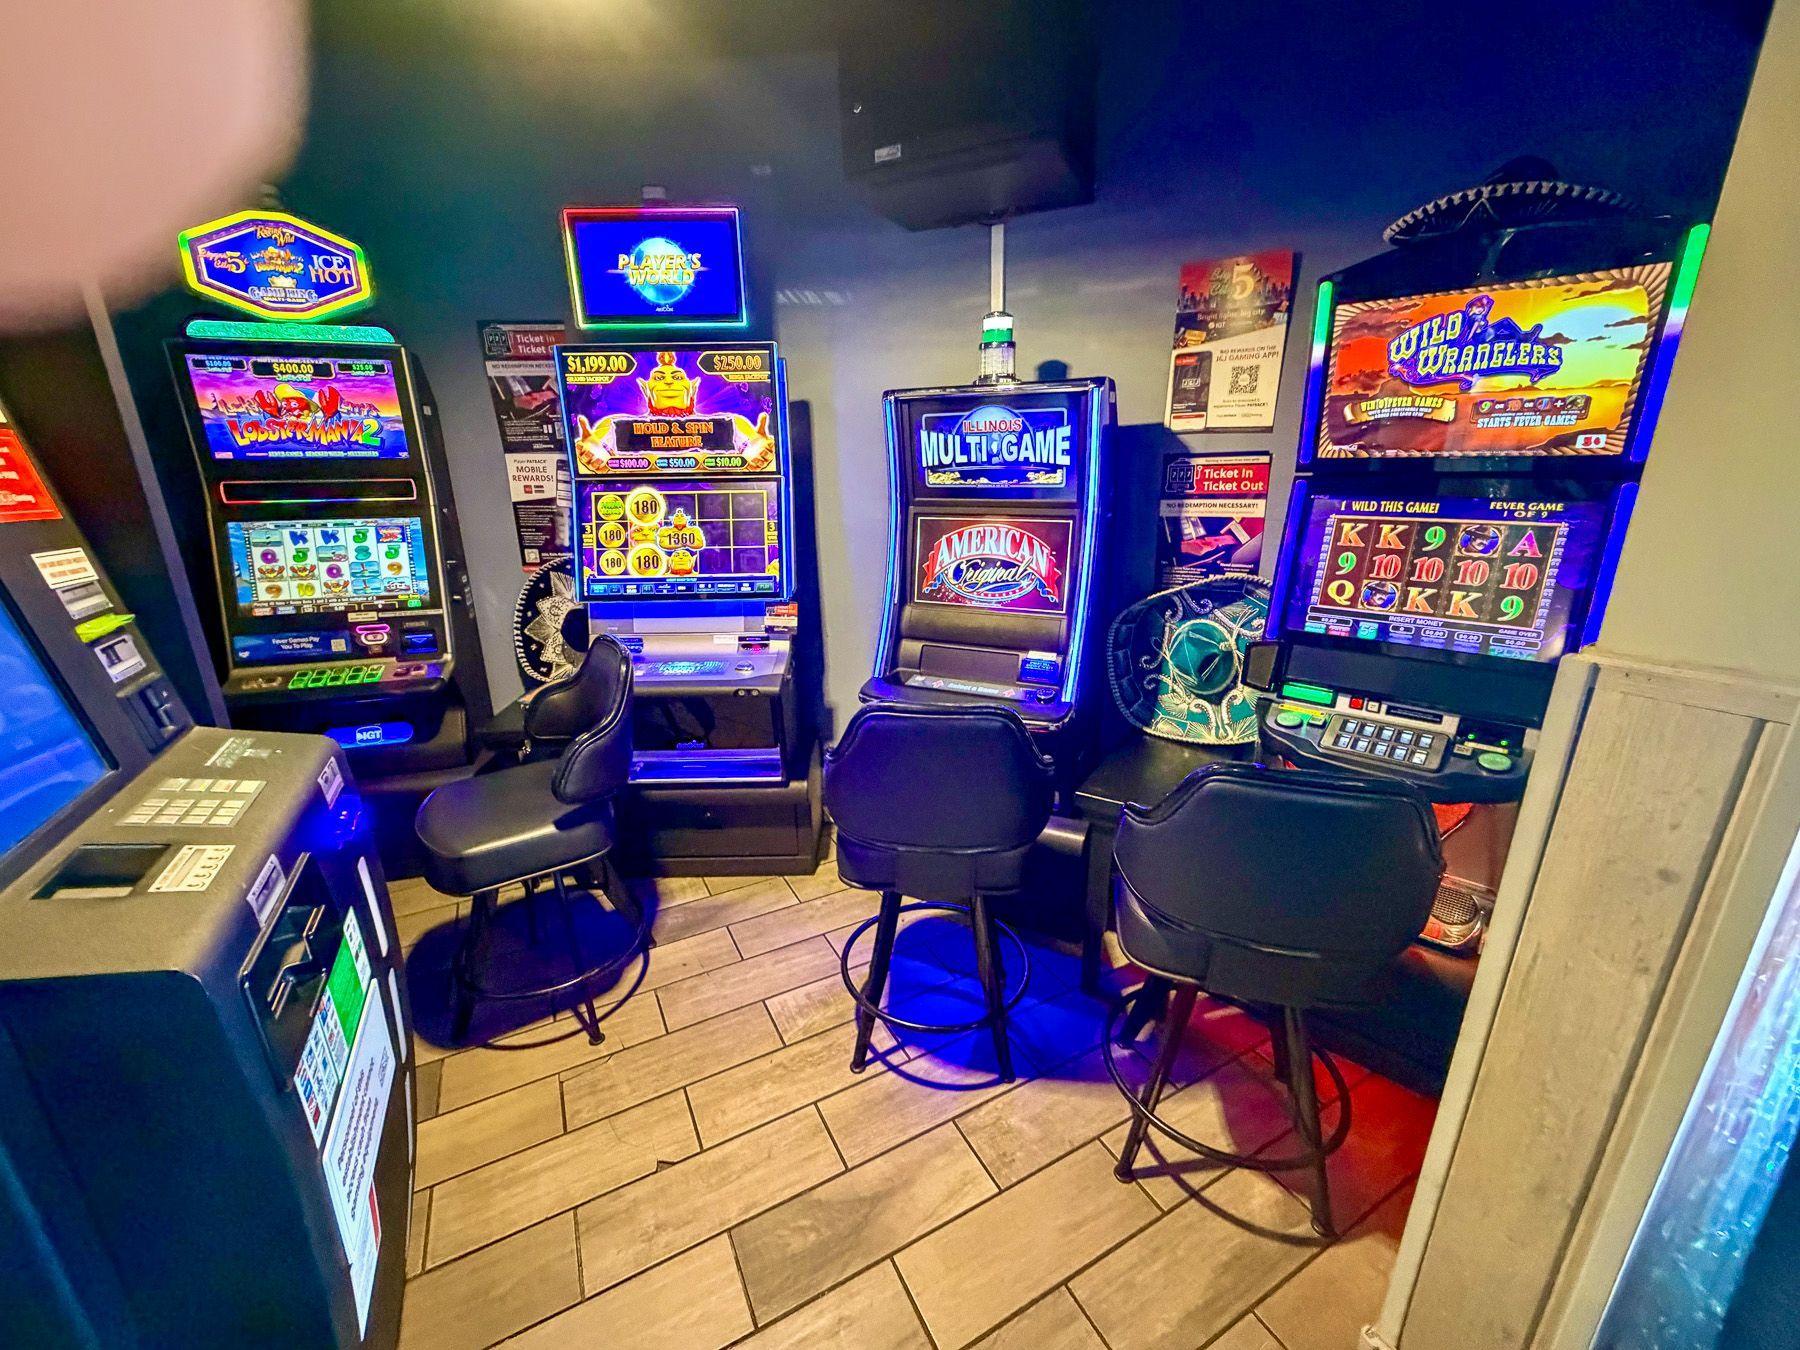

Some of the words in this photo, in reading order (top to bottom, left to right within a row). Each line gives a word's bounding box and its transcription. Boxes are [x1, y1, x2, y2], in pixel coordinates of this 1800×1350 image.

[311, 254, 345, 270] ICE
[618, 253, 702, 271] PLAYER'S
[308, 264, 352, 285] HOT
[629, 269, 695, 286] WORLD
[515, 333, 545, 343] Ticket
[546, 334, 556, 342] In
[1390, 312, 1463, 363] WILD
[518, 344, 547, 354] Ticket
[567, 355, 628, 373] $1,199.00
[713, 355, 762, 371] $250.00
[1418, 341, 1562, 377] WRANGLERS
[272, 362, 314, 374] $400.00
[633, 422, 670, 435] HOLD
[671, 423, 684, 434] &
[685, 422, 714, 434] SPIN
[963, 418, 1023, 433] ILLINOIS
[1477, 416, 1512, 428] STARTS
[1513, 415, 1543, 427] FEVER
[1544, 414, 1578, 426] GAMES
[362, 418, 382, 446] 2
[651, 436, 704, 448] FEATURE
[920, 429, 988, 467] MULTI
[1001, 424, 1072, 466] GAME
[669, 460, 696, 468] $50.00
[716, 459, 742, 467] $10.00
[1204, 468, 1239, 479] Ticket
[1241, 468, 1254, 478] In
[1203, 481, 1237, 491] Ticket
[1240, 481, 1264, 491] Out
[634, 500, 658, 515] 180
[1352, 501, 1378, 512] WILD
[1380, 501, 1404, 513] THIS
[1405, 502, 1440, 514] GAME!
[1489, 501, 1525, 510] FEVER
[1528, 502, 1565, 512] GAME
[1541, 511, 1548, 519] 9
[289, 531, 309, 547] K
[320, 531, 340, 546] K
[353, 529, 369, 544] J
[604, 530, 622, 541] 180
[667, 533, 696, 546] 1360
[1337, 522, 1369, 548] K
[1375, 524, 1410, 549] K
[1422, 526, 1447, 552] 9
[1507, 529, 1543, 558] A
[260, 548, 279, 564] Q
[293, 547, 309, 563] J
[385, 545, 400, 560] J
[934, 526, 1048, 577] AMERICAN
[606, 557, 622, 568] 180
[636, 555, 659, 569] 180
[326, 564, 344, 579] Q
[387, 561, 403, 575] 9
[949, 557, 1034, 592] Original
[1335, 551, 1357, 576] 9
[1369, 554, 1402, 580] 10
[1410, 556, 1445, 583] 10
[1453, 559, 1490, 586] 10
[1500, 562, 1538, 591] 10
[265, 584, 283, 599] 9
[1327, 579, 1355, 606] Q
[1403, 587, 1438, 614] K
[1445, 590, 1483, 618] K
[1497, 595, 1525, 622] 9
[1388, 616, 1414, 624] INSERT
[1416, 619, 1444, 627] MONEY
[1495, 650, 1530, 660] PLAY
